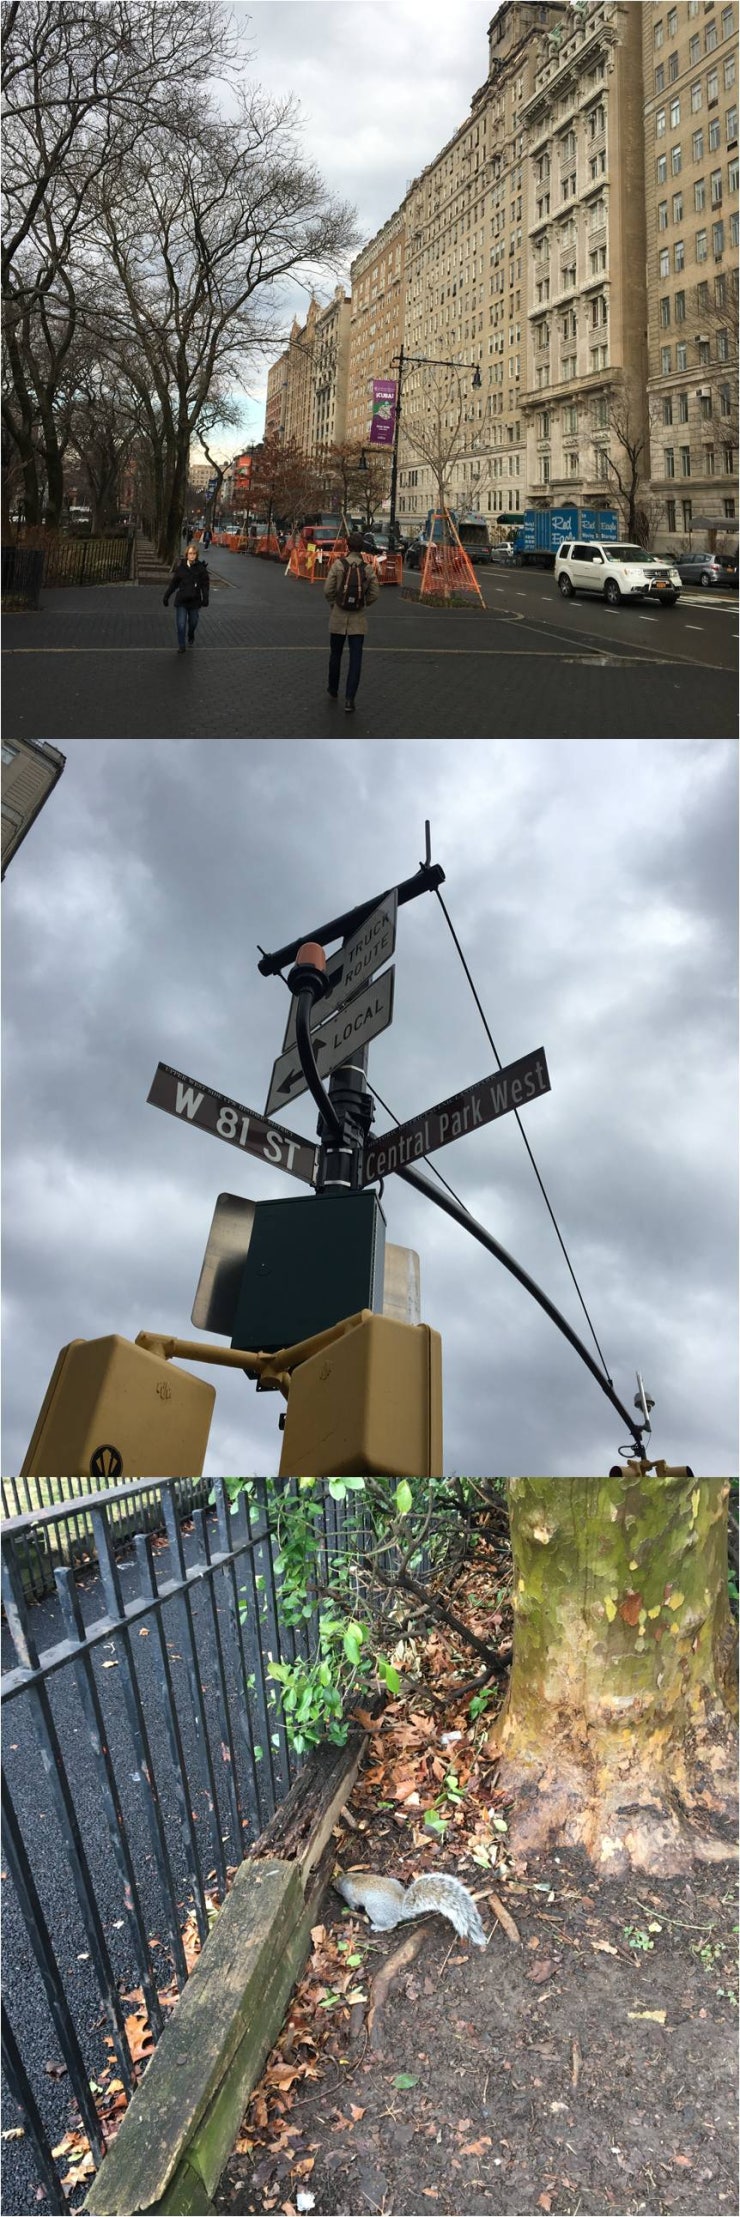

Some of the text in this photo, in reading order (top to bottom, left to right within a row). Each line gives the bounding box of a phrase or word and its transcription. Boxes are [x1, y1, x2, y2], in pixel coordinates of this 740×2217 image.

[551, 516, 572, 530] Red
[345, 932, 389, 986] ROUTE
[349, 912, 389, 963] TRUCK
[333, 999, 384, 1049] LOCAL
[175, 1081, 301, 1171] W 81 ST
[366, 1121, 431, 1181] Central
[439, 1096, 483, 1143] Park
[490, 1061, 546, 1114] West
